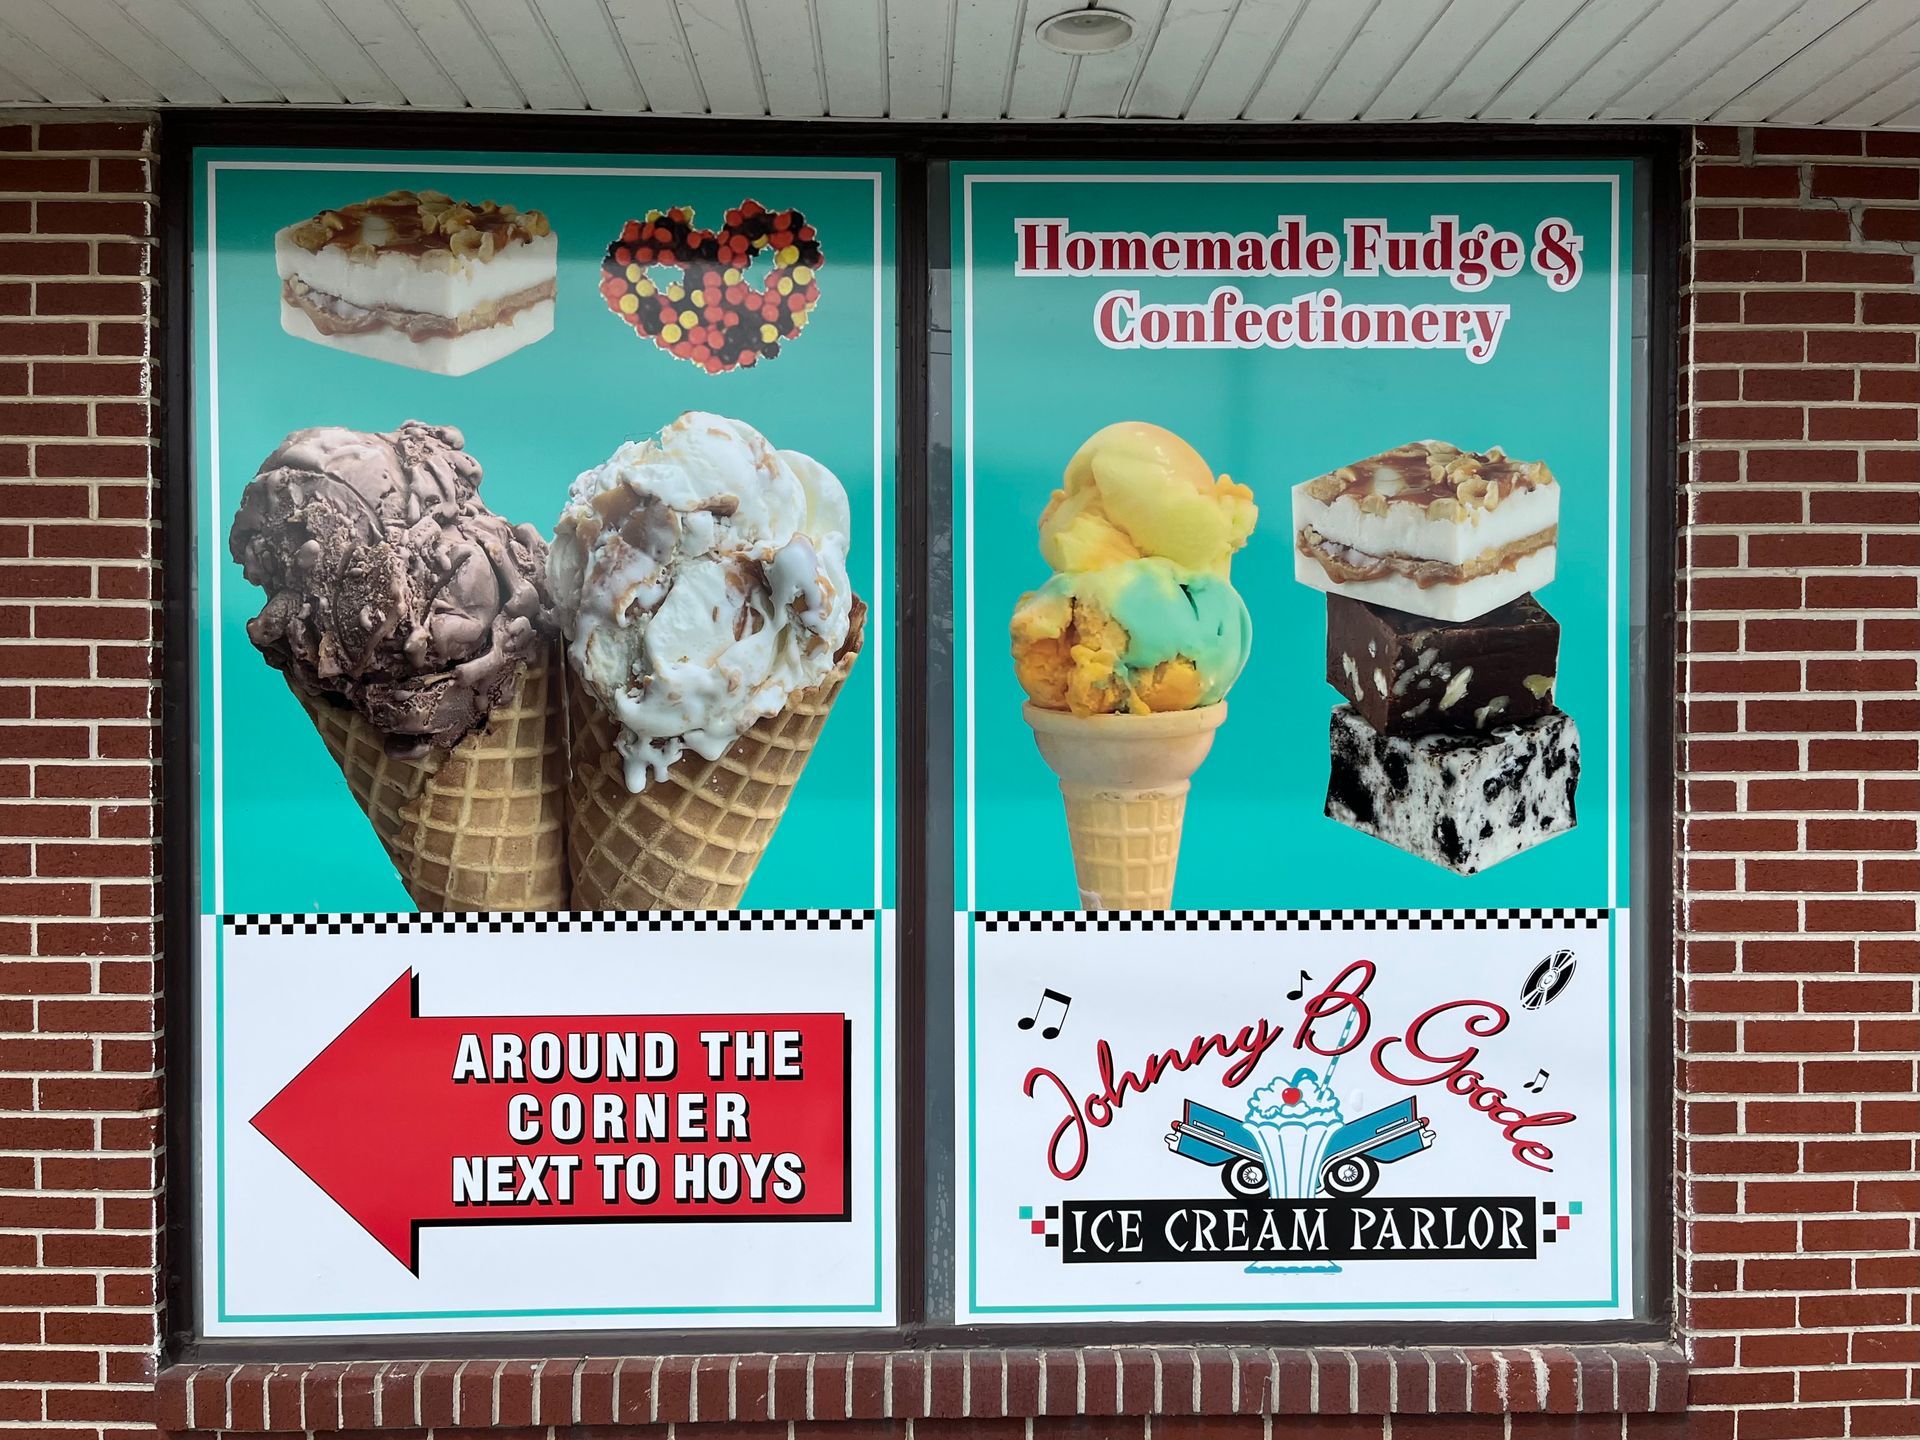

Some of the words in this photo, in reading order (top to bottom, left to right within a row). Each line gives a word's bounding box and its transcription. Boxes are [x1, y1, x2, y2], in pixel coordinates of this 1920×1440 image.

[1021, 220, 1336, 272] Homemade
[1350, 220, 1519, 286] Fudge
[1537, 220, 1582, 285] &
[1099, 292, 1504, 358] Confectionery
[453, 1031, 677, 1082] AROUND
[700, 1030, 804, 1079] THE
[1022, 1017, 1284, 1181] Johnny
[1293, 959, 1376, 1056] B
[1371, 1000, 1576, 1173] Goode
[508, 1092, 751, 1142] CORNER
[452, 1154, 582, 1205] NEXT
[595, 1154, 660, 1203] TO
[674, 1152, 806, 1201] HOYS
[1069, 1208, 1144, 1254] ICE
[1164, 1206, 1328, 1253] CREAM
[1352, 1205, 1530, 1252] PARLOR
